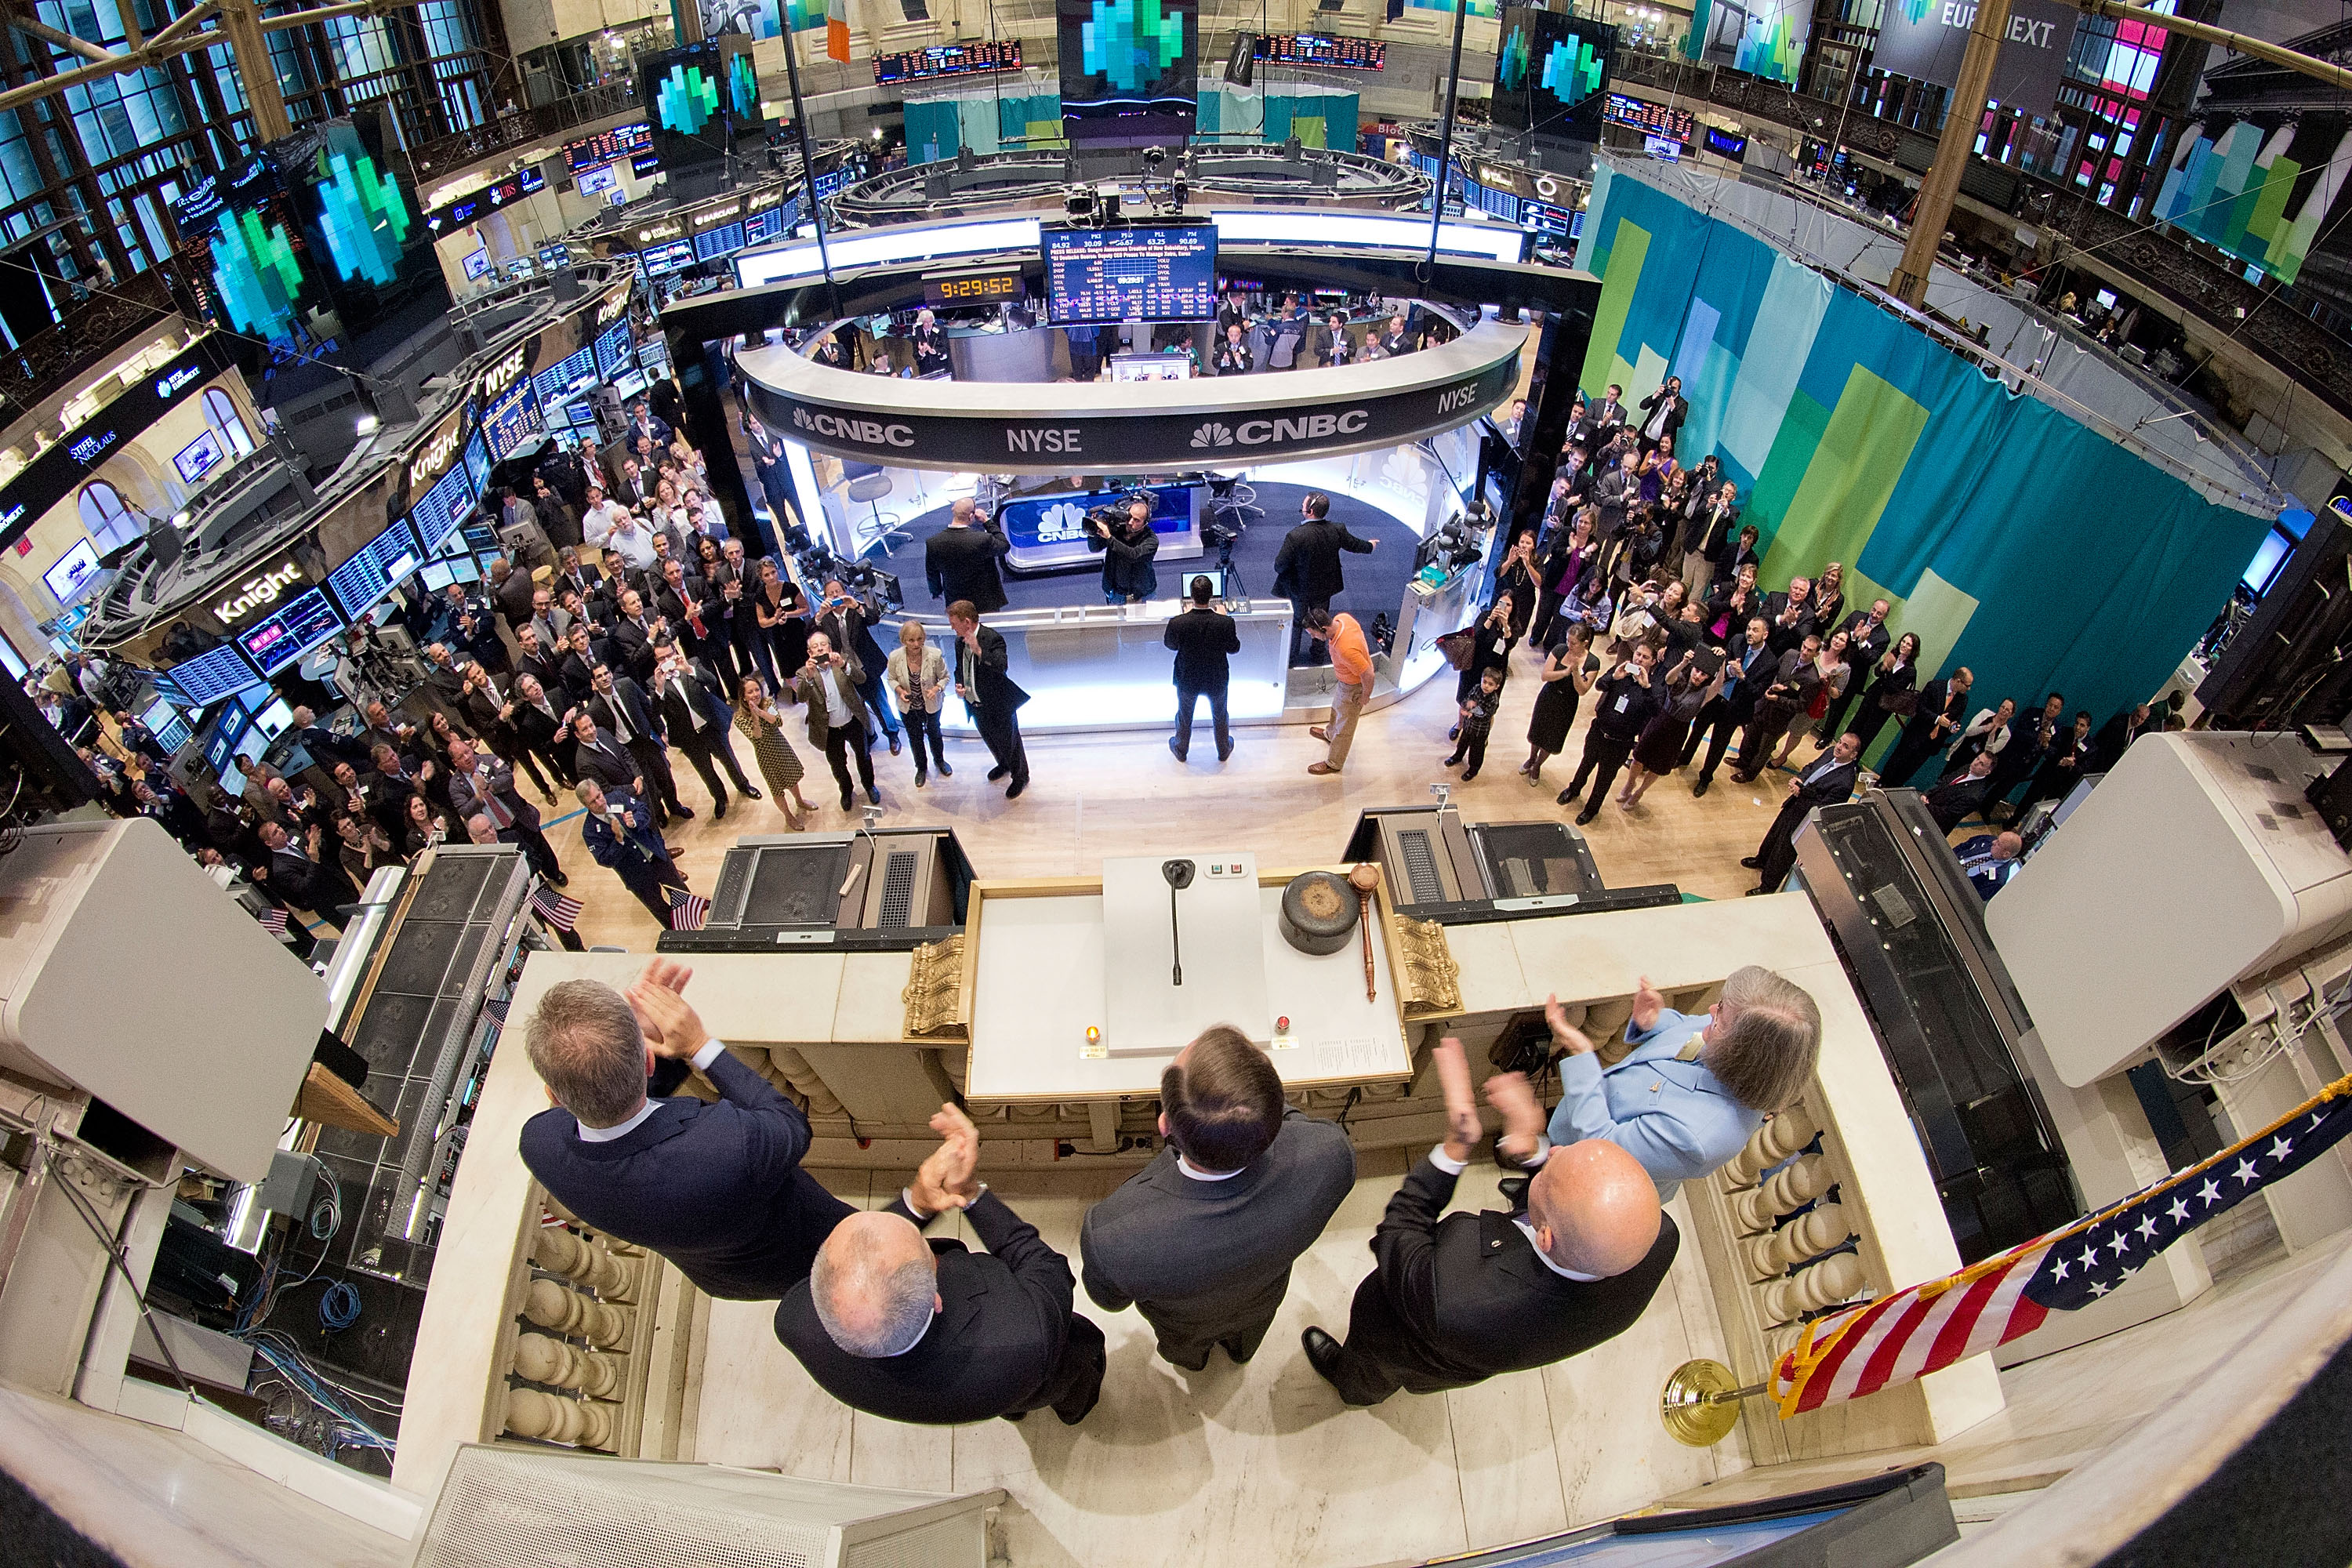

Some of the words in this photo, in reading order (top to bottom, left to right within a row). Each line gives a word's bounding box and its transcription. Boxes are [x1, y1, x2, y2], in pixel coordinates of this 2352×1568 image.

[1940, 2, 2056, 49] EUREXT
[499, 183, 516, 199] UBS
[703, 205, 739, 223] BARCLAYS
[941, 278, 1013, 298] 9:29:52
[597, 290, 630, 326] Knight
[169, 369, 183, 384] NYSE
[171, 367, 201, 390] EURONEXT
[485, 348, 524, 397] NYSE
[1438, 383, 1479, 414] NYSE
[814, 414, 915, 447] CNBC
[1007, 429, 1082, 452] NYSE
[1236, 410, 1369, 445] CNBC
[71, 437, 96, 459] STIFEL
[78, 431, 116, 464] NICOLAUS
[411, 426, 459, 488] Knight
[213, 562, 303, 624] Knight
[305, 627, 325, 643] NUVEEN
